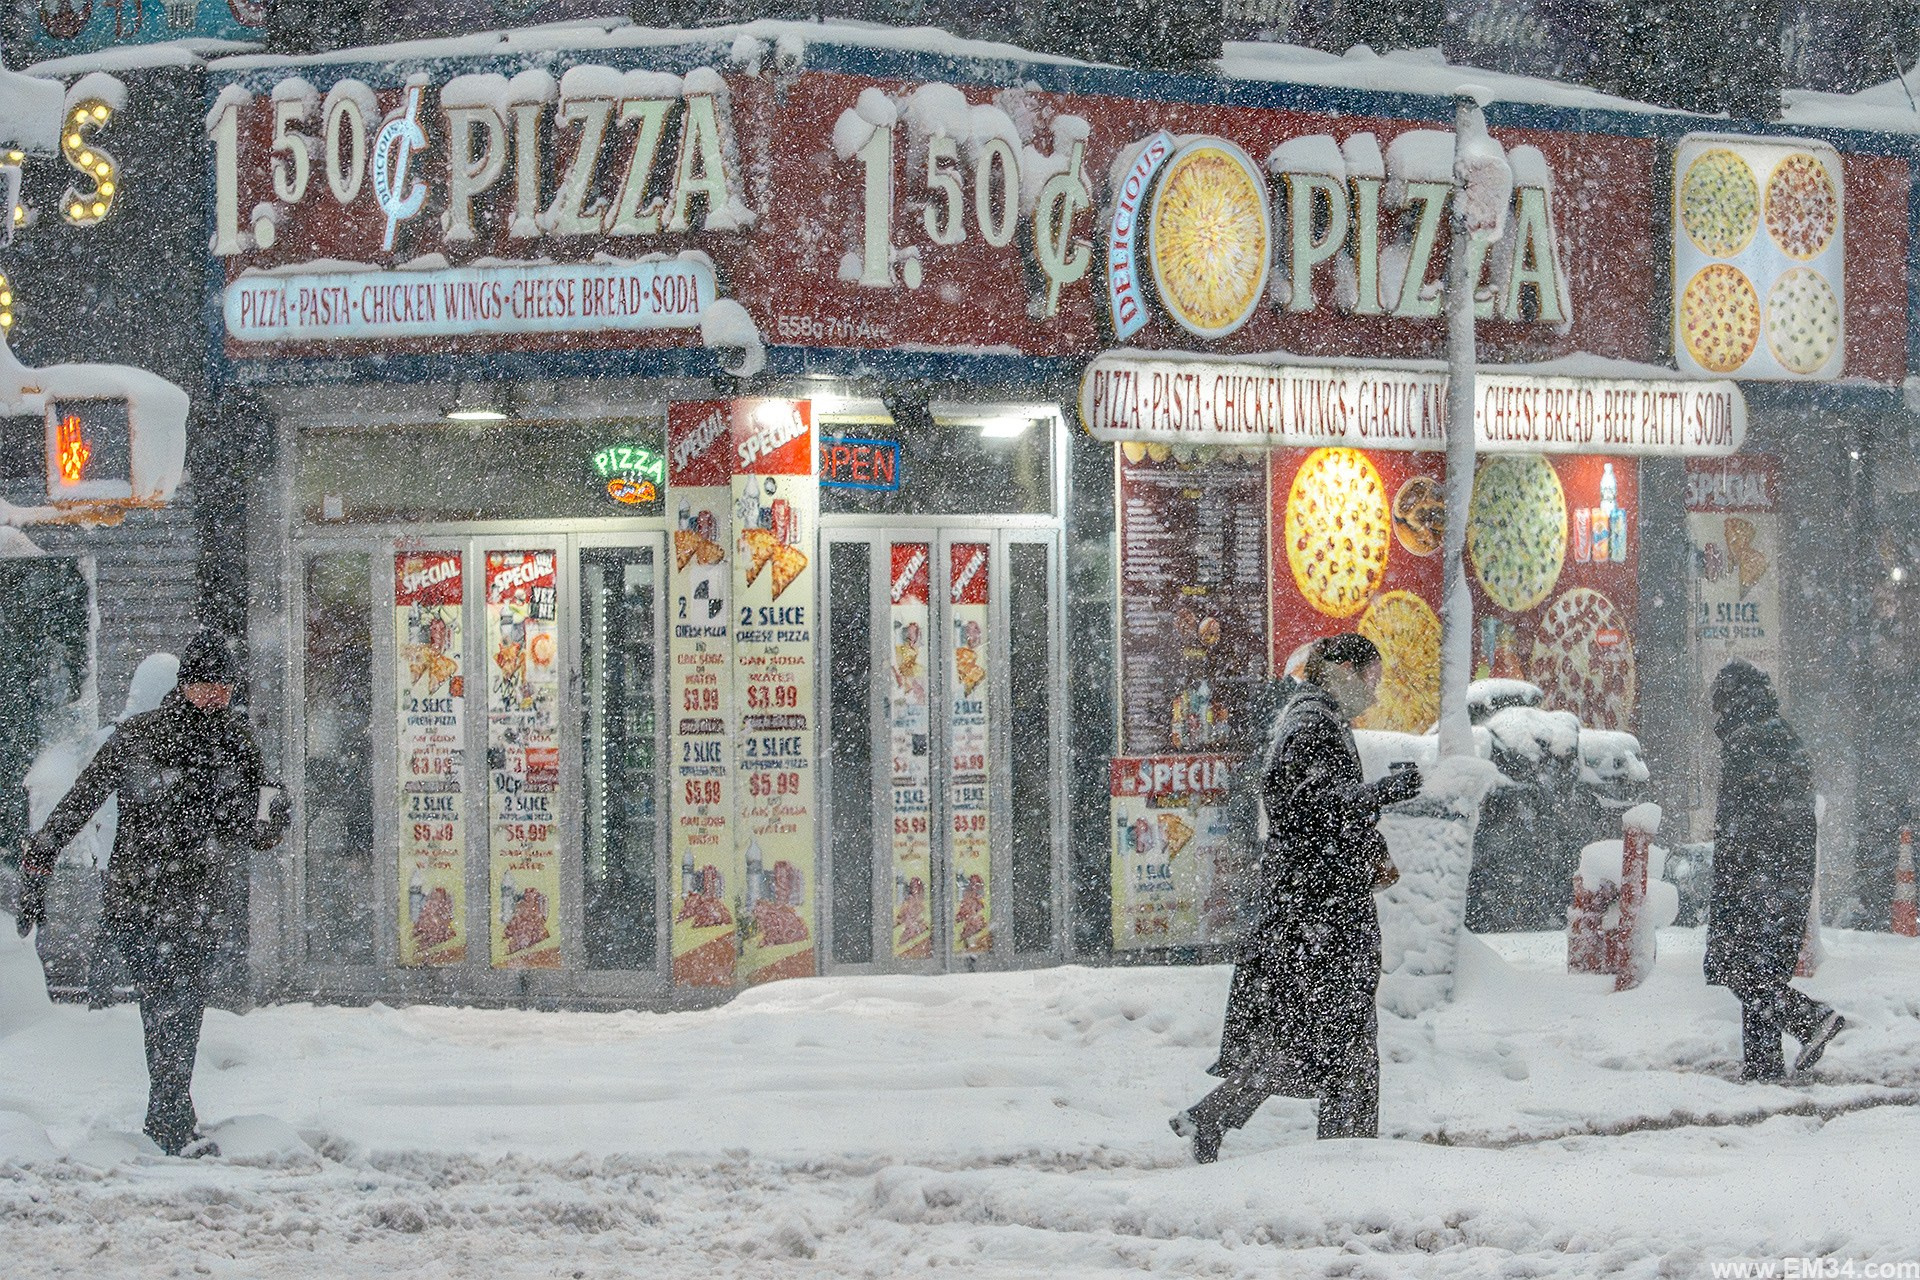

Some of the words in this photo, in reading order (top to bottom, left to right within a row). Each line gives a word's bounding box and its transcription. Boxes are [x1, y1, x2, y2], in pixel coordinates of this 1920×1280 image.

[443, 93, 755, 241] PIZZA
[1111, 138, 1167, 326] DELICIOUS
[240, 288, 288, 329] PIZZA
[299, 286, 350, 326] PASTA
[361, 284, 437, 323] CHICKEN
[443, 281, 502, 320] WINGS
[512, 279, 576, 319] CHEESE
[582, 276, 641, 317] BREAD
[652, 274, 699, 314] SODA
[1093, 369, 1140, 430] PIZZA
[1152, 372, 1202, 431] PASTA
[1214, 375, 1284, 434] CHICKEN
[1293, 379, 1347, 437] WINGS
[1359, 381, 1417, 438] GARLIC
[1485, 386, 1539, 441] CHEESE
[1545, 388, 1594, 443] BREAD
[1604, 390, 1637, 444] BEEF
[1642, 391, 1688, 445] PATTY
[1695, 391, 1733, 446] SODA
[674, 409, 727, 473] SPECIAL
[737, 410, 809, 469] SPECIAL
[593, 446, 665, 483] PIZZA
[403, 559, 460, 595] SPECIAL
[741, 606, 752, 626] 2
[758, 606, 805, 626] SLICE
[1715, 602, 1759, 622] SLICE
[777, 630, 810, 642] PIZZA
[410, 698, 418, 713] 2
[422, 698, 453, 713] SLICE
[747, 684, 797, 709] $3.99
[683, 741, 692, 762] 2
[694, 741, 722, 762] SLICE
[745, 737, 757, 757] 2
[763, 736, 801, 757] SLICE
[750, 772, 800, 797] $5.99
[412, 797, 419, 811] 2
[423, 796, 454, 811] SLICE
[505, 797, 511, 811] 2
[517, 796, 548, 811] SLICE
